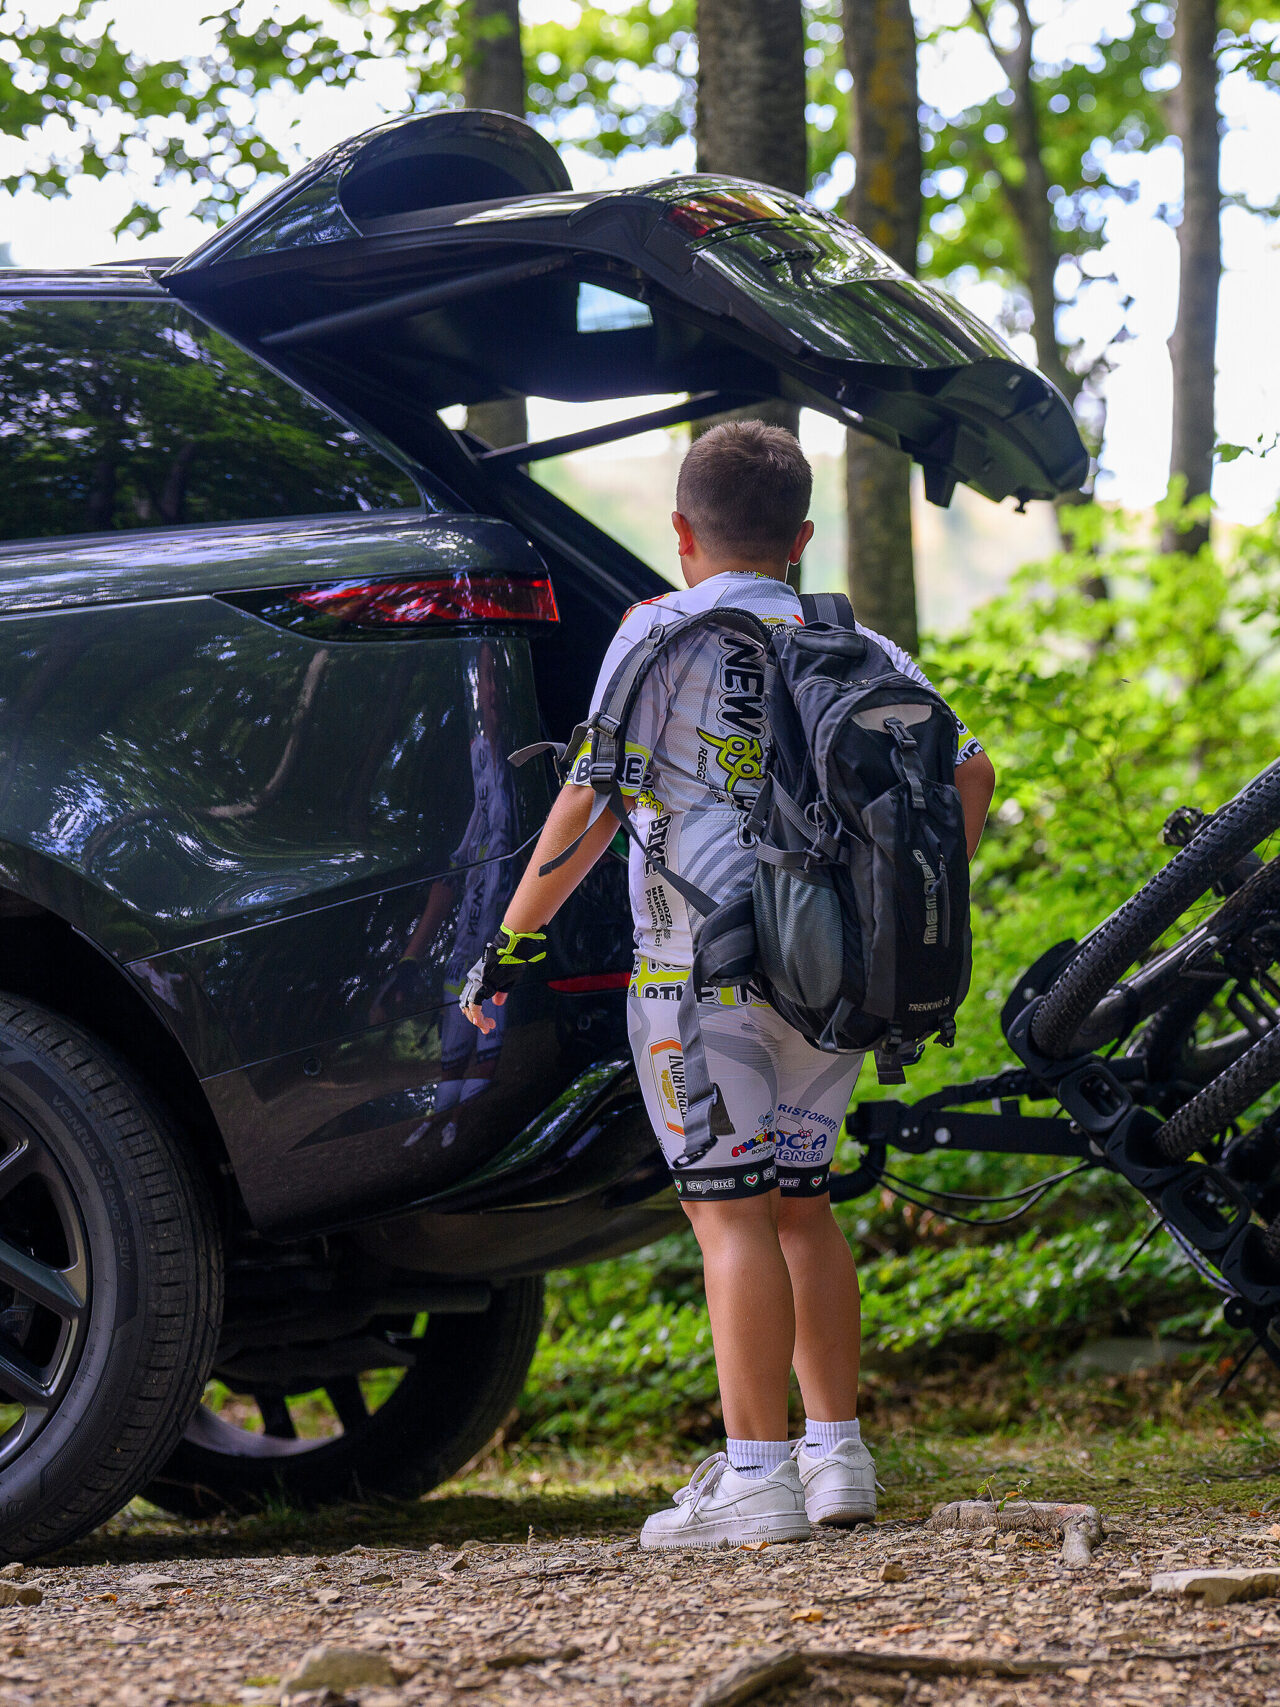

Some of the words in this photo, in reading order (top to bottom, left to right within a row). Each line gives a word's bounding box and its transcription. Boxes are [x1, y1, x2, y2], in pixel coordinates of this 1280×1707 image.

[717, 634, 767, 738] NEW
[573, 752, 646, 788] BE
[696, 746, 709, 783] REGG
[645, 890, 662, 947] Pneumtici
[651, 887, 665, 922] MARCO
[657, 885, 673, 928] MENOZZI
[908, 999, 943, 1012] TREKKING
[777, 1103, 838, 1133] RISTORANTE
[775, 1148, 823, 1162] IANCA
[686, 1180, 704, 1191] NEW
[712, 1178, 735, 1190] BIKE
[779, 1177, 801, 1188] BIKE
